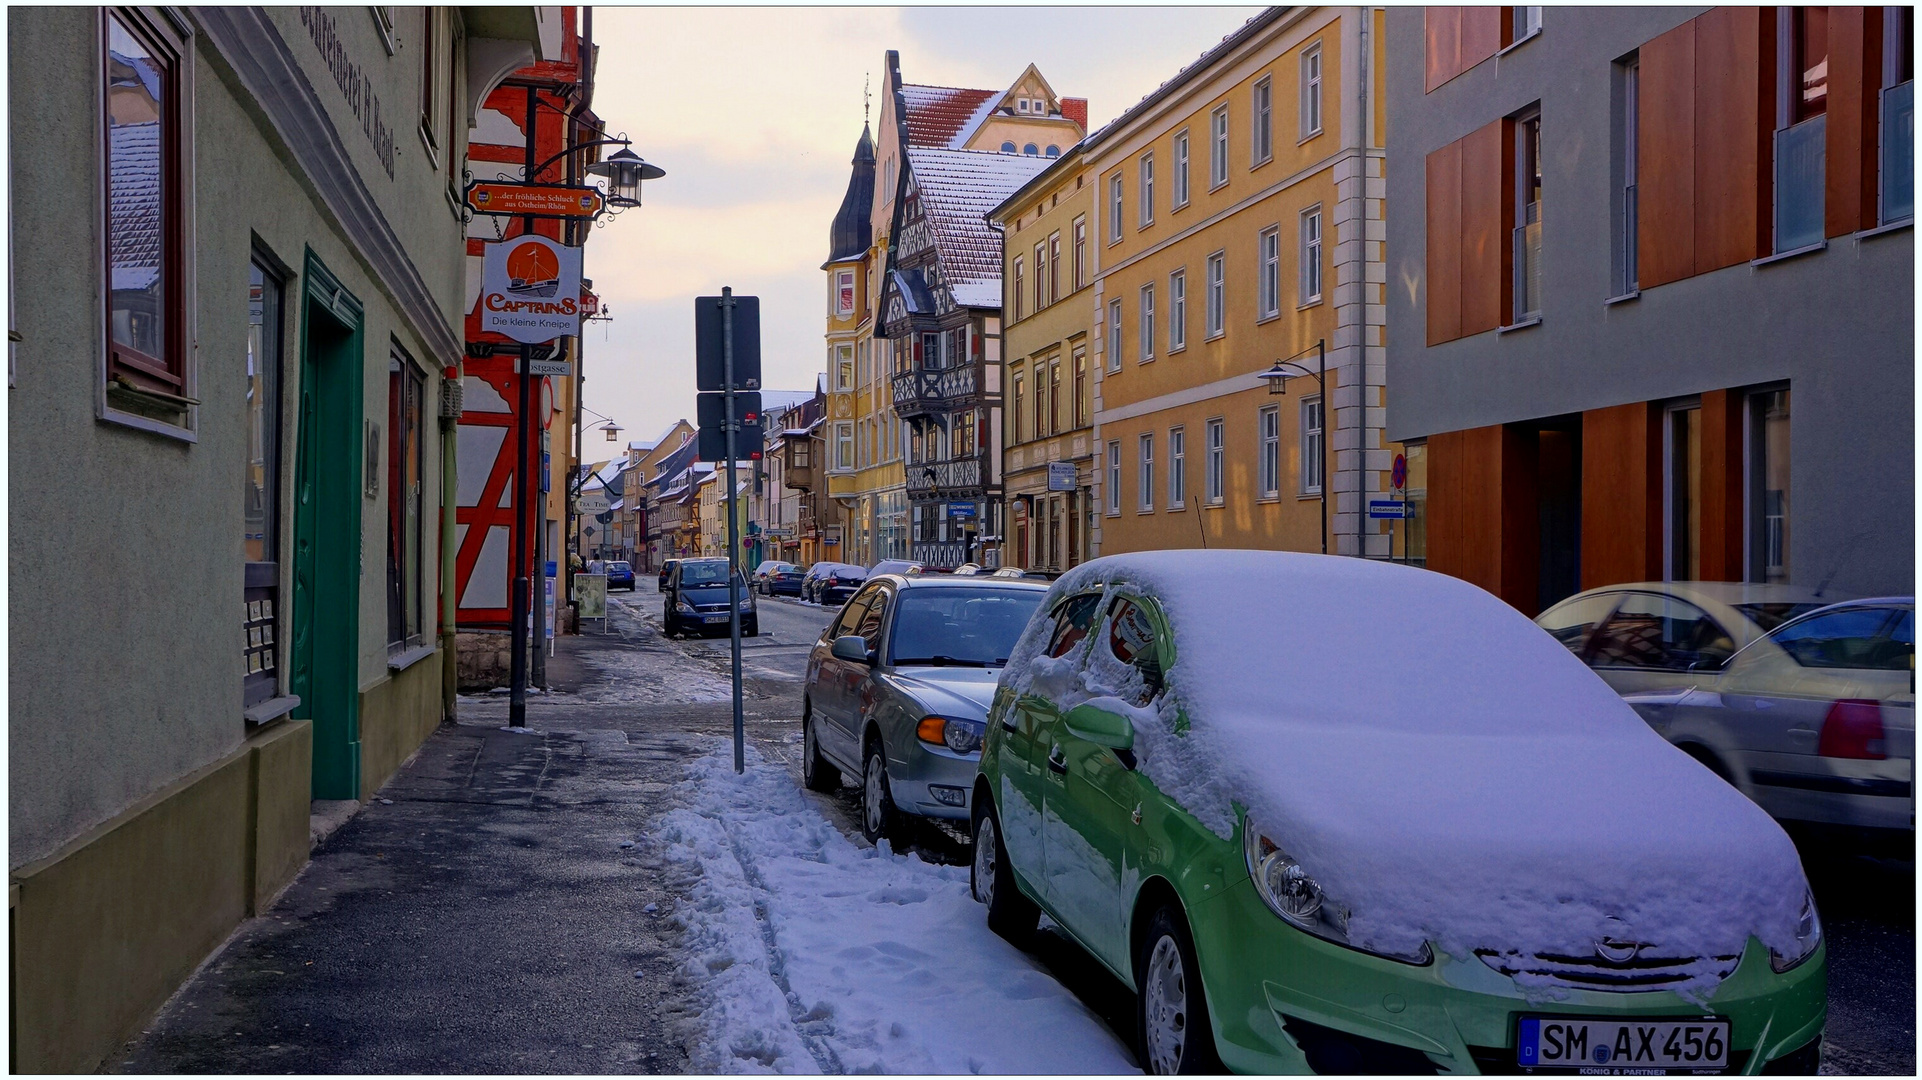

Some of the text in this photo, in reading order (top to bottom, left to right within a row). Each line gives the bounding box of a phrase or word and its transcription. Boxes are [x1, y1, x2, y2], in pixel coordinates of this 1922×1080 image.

[515, 191, 546, 201] fröhliche
[547, 193, 575, 203] Schluck
[517, 200, 566, 210] Ostheim/Rhön
[492, 316, 571, 330] Die kleine Kneipe
[1542, 1024, 1724, 1062] SM AX 456
[1579, 1067, 1610, 1075] KÖNIG
